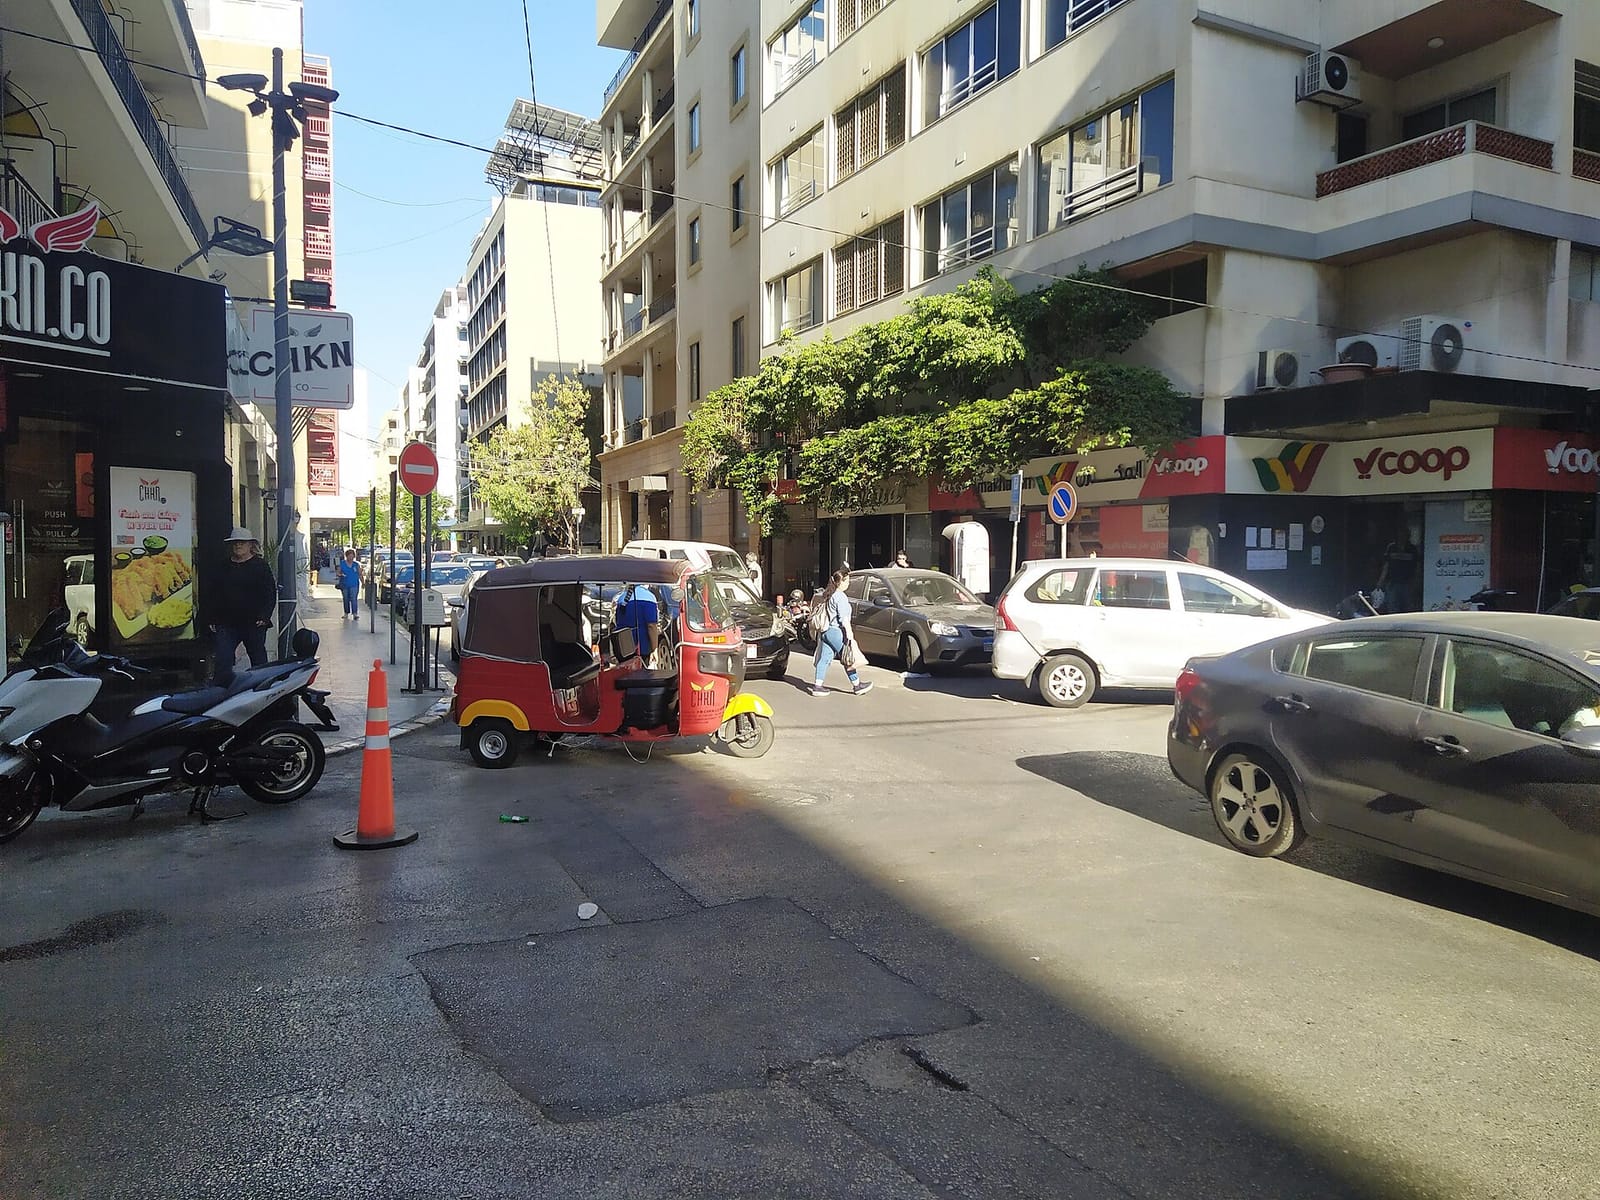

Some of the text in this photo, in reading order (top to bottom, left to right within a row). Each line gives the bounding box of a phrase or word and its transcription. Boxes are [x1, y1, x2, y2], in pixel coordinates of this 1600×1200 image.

[249, 341, 352, 377] CIKN
[295, 383, 310, 392] CO
[44, 511, 66, 519] PUSH
[46, 530, 66, 538] PULL
